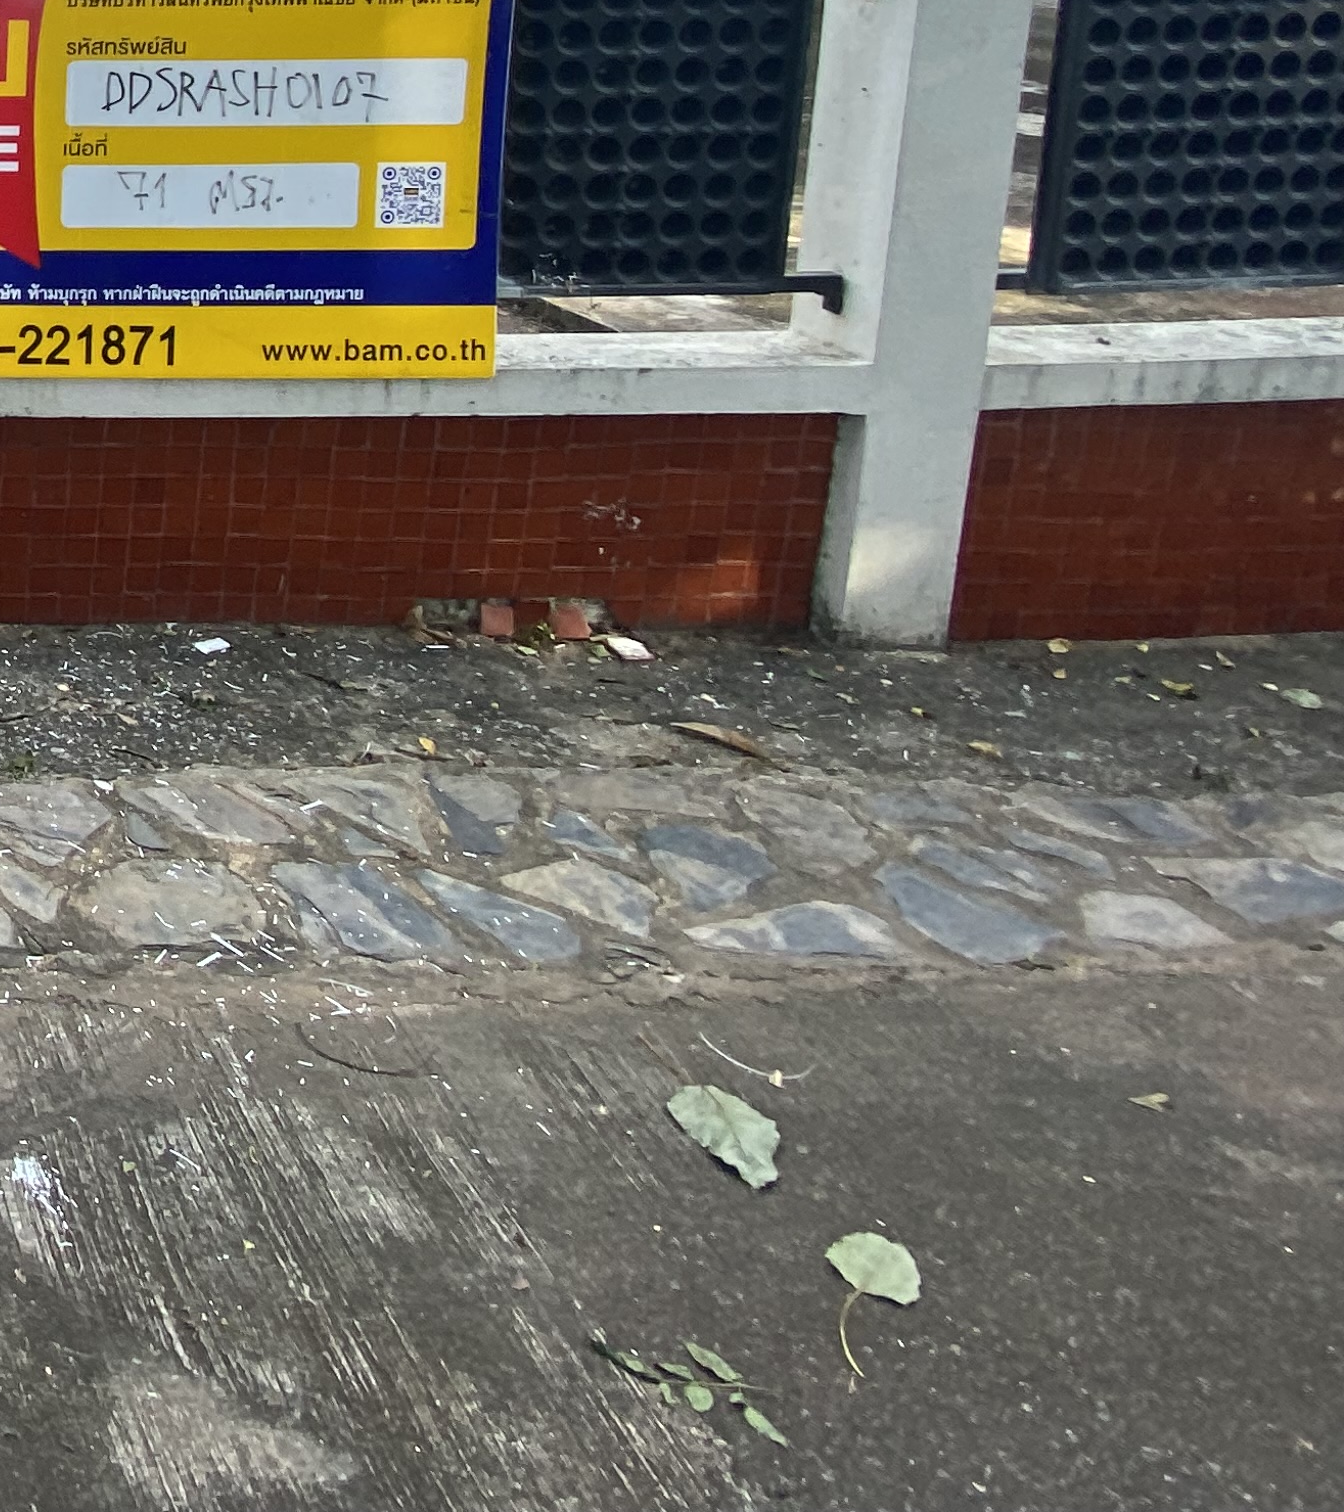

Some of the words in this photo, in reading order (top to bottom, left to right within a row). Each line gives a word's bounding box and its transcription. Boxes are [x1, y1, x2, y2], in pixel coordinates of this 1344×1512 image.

[65, 37, 187, 56] รหัสทรัพย์สิน
[62, 132, 108, 157] เนื้อที่
[116, 170, 169, 211] 71
[27, 284, 98, 306] ห้ามบุกรุก
[261, 338, 486, 362] www.bam.co.th
